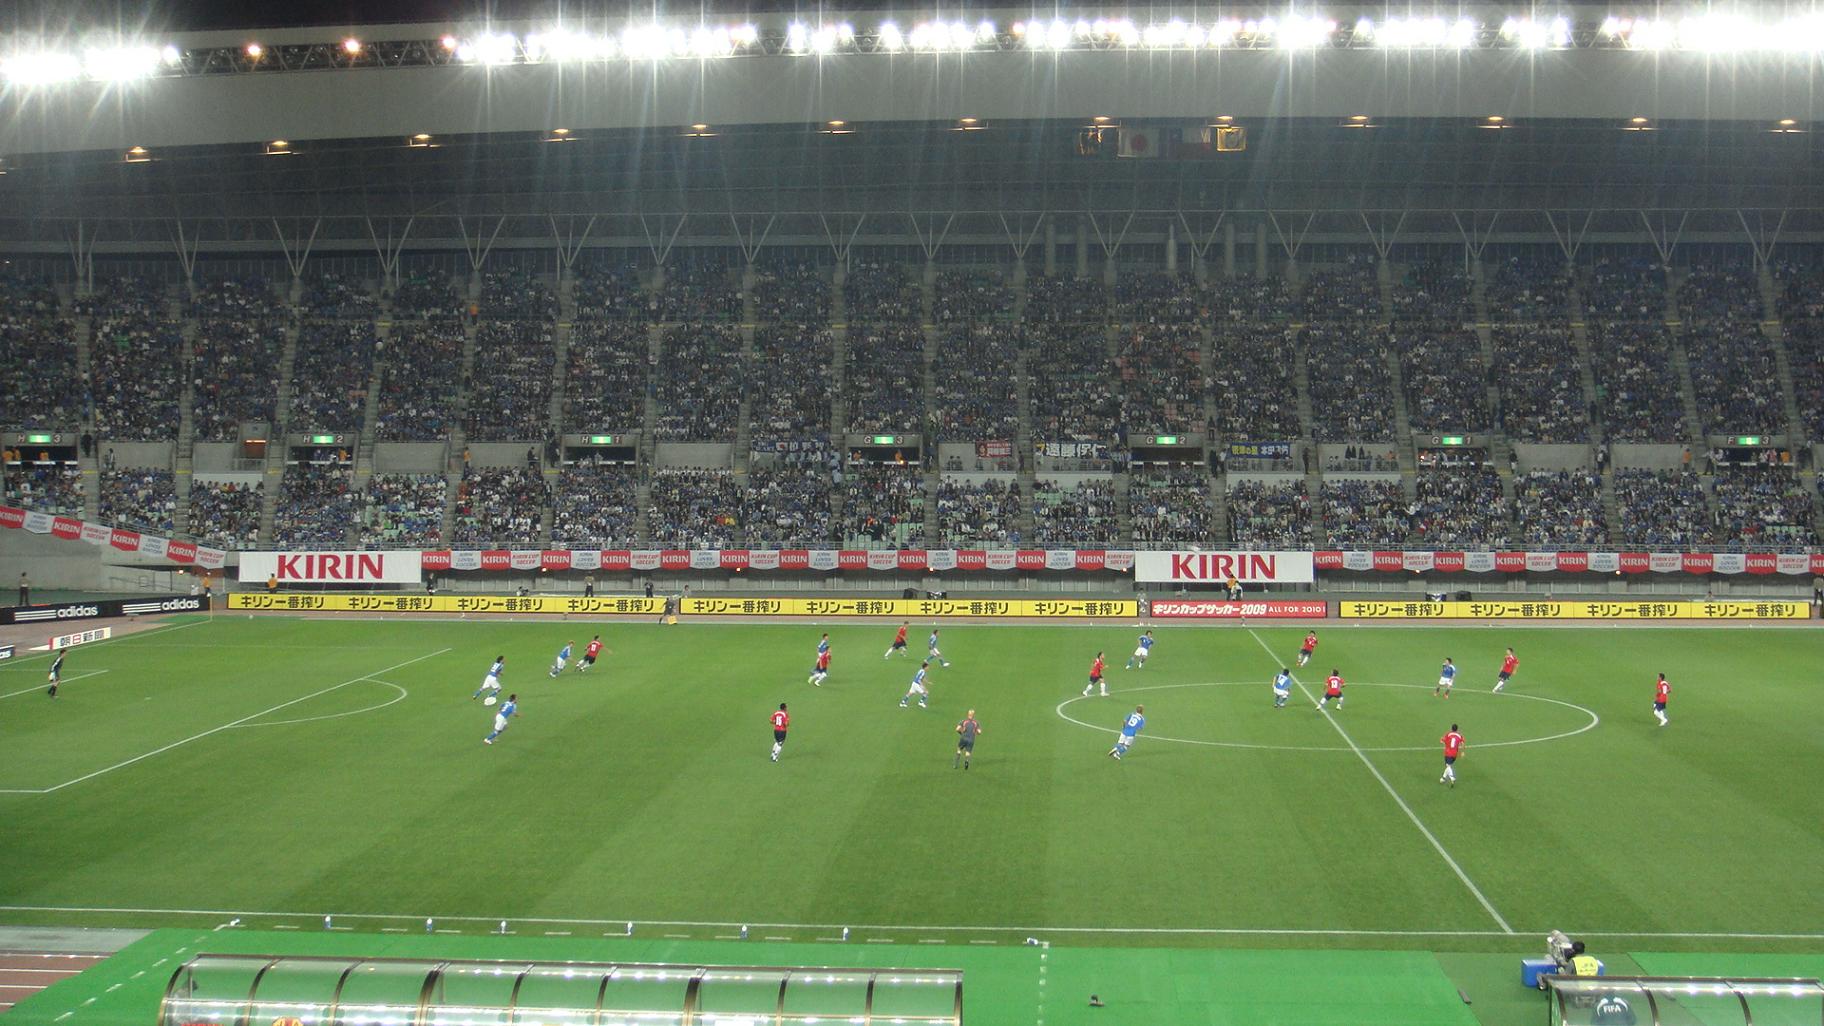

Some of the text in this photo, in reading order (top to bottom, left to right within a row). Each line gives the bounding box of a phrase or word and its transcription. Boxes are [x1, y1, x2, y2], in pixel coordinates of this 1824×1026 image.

[54, 522, 80, 534] KIRIN
[112, 534, 138, 546] KIRIN
[169, 546, 194, 558] KIRIN
[422, 555, 449, 564] KIRIN
[482, 555, 509, 564] KIRIN
[543, 555, 569, 563] KIRIN
[602, 555, 628, 564] KIRIN
[662, 555, 689, 563] KIRIN
[721, 555, 748, 563] KIRIN
[781, 555, 807, 563] KIRIN
[840, 555, 866, 563] KIRIN
[899, 555, 926, 563] KIRIN
[958, 555, 984, 563] KIRIN
[1018, 555, 1044, 563] KIRIN
[1077, 555, 1103, 563] KIRIN
[1315, 555, 1342, 564] KIRIN
[1375, 556, 1401, 564] KIRIN
[1436, 556, 1463, 565] KIRIN
[1497, 556, 1525, 565] KIRIN
[1559, 556, 1586, 565] KIRIN
[1620, 557, 1648, 566] KIRIN
[1684, 559, 1712, 567] KIRIN
[1747, 559, 1775, 567] KIRIN
[278, 554, 383, 579] KIRIN
[1172, 554, 1276, 579] KIRIN
[162, 599, 199, 610] adidas
[241, 596, 324, 608] キリン一番搾り
[349, 597, 432, 609] キリン一番搾り
[458, 598, 542, 610] キリン一番搾り
[568, 599, 654, 611] キリン一番搾り
[694, 600, 781, 612] キリン一番搾り
[58, 606, 98, 617] adidas
[806, 601, 894, 614] キリン一番搾り
[920, 602, 1008, 614] キリン一番搾り
[1035, 603, 1124, 615] キリン一番搾り
[1354, 604, 1444, 616] キリン一番搾り
[1470, 604, 1560, 616] キリン一番搾り
[1587, 604, 1677, 616] キリン一番搾り
[1704, 604, 1795, 616] キリン一番搾り
[1603, 1005, 1621, 1013] FIFA
